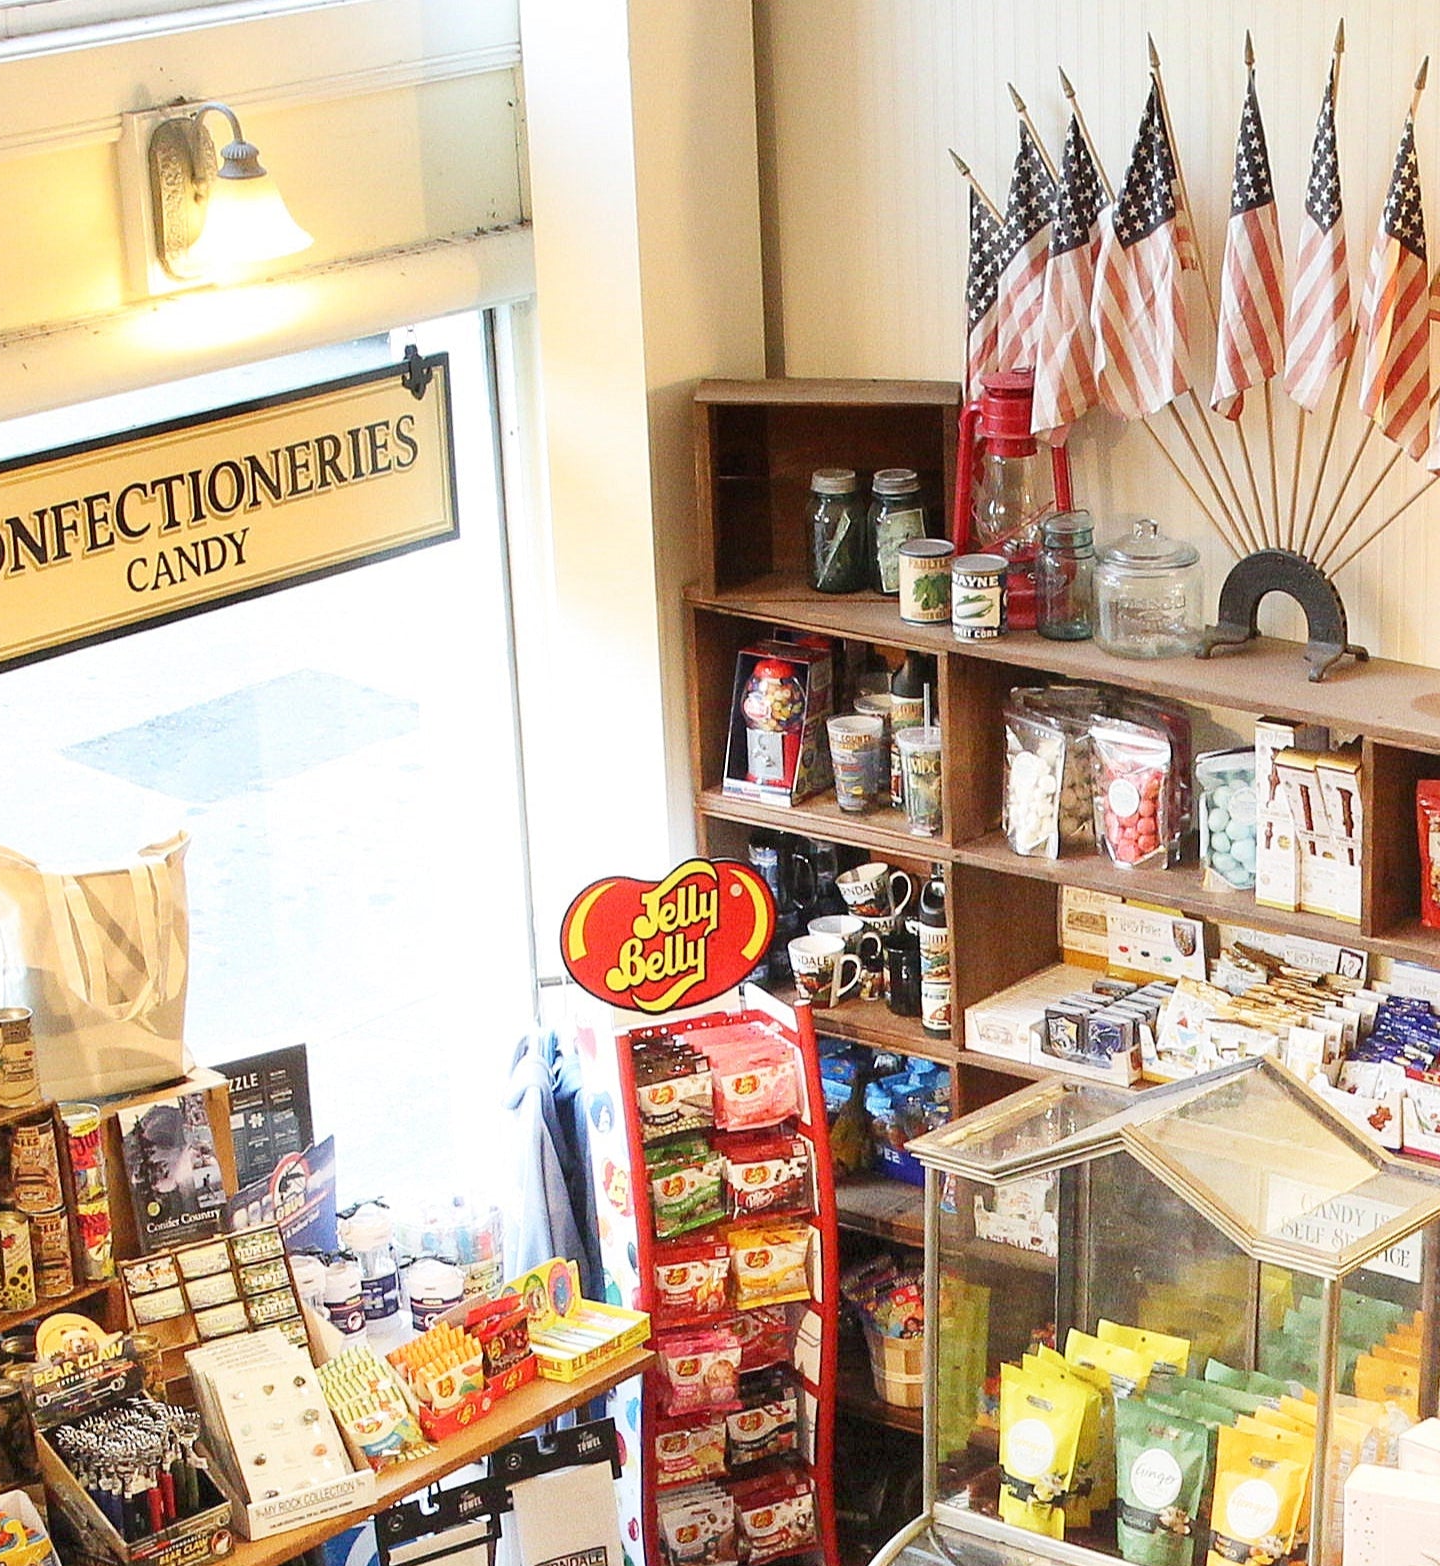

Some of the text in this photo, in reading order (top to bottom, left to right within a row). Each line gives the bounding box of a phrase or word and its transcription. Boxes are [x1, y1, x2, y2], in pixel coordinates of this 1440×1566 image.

[125, 528, 250, 593] CANDY
[633, 882, 719, 939] Jelly
[605, 935, 705, 993] Belly
[181, 1207, 223, 1226] Country
[1281, 1214, 1326, 1248] SELF
[33, 1339, 124, 1389] BEAR CLAW
[577, 1440, 603, 1454] TOWEL
[304, 1482, 356, 1506] COLLECTION
[458, 1497, 483, 1513] TOWEL
